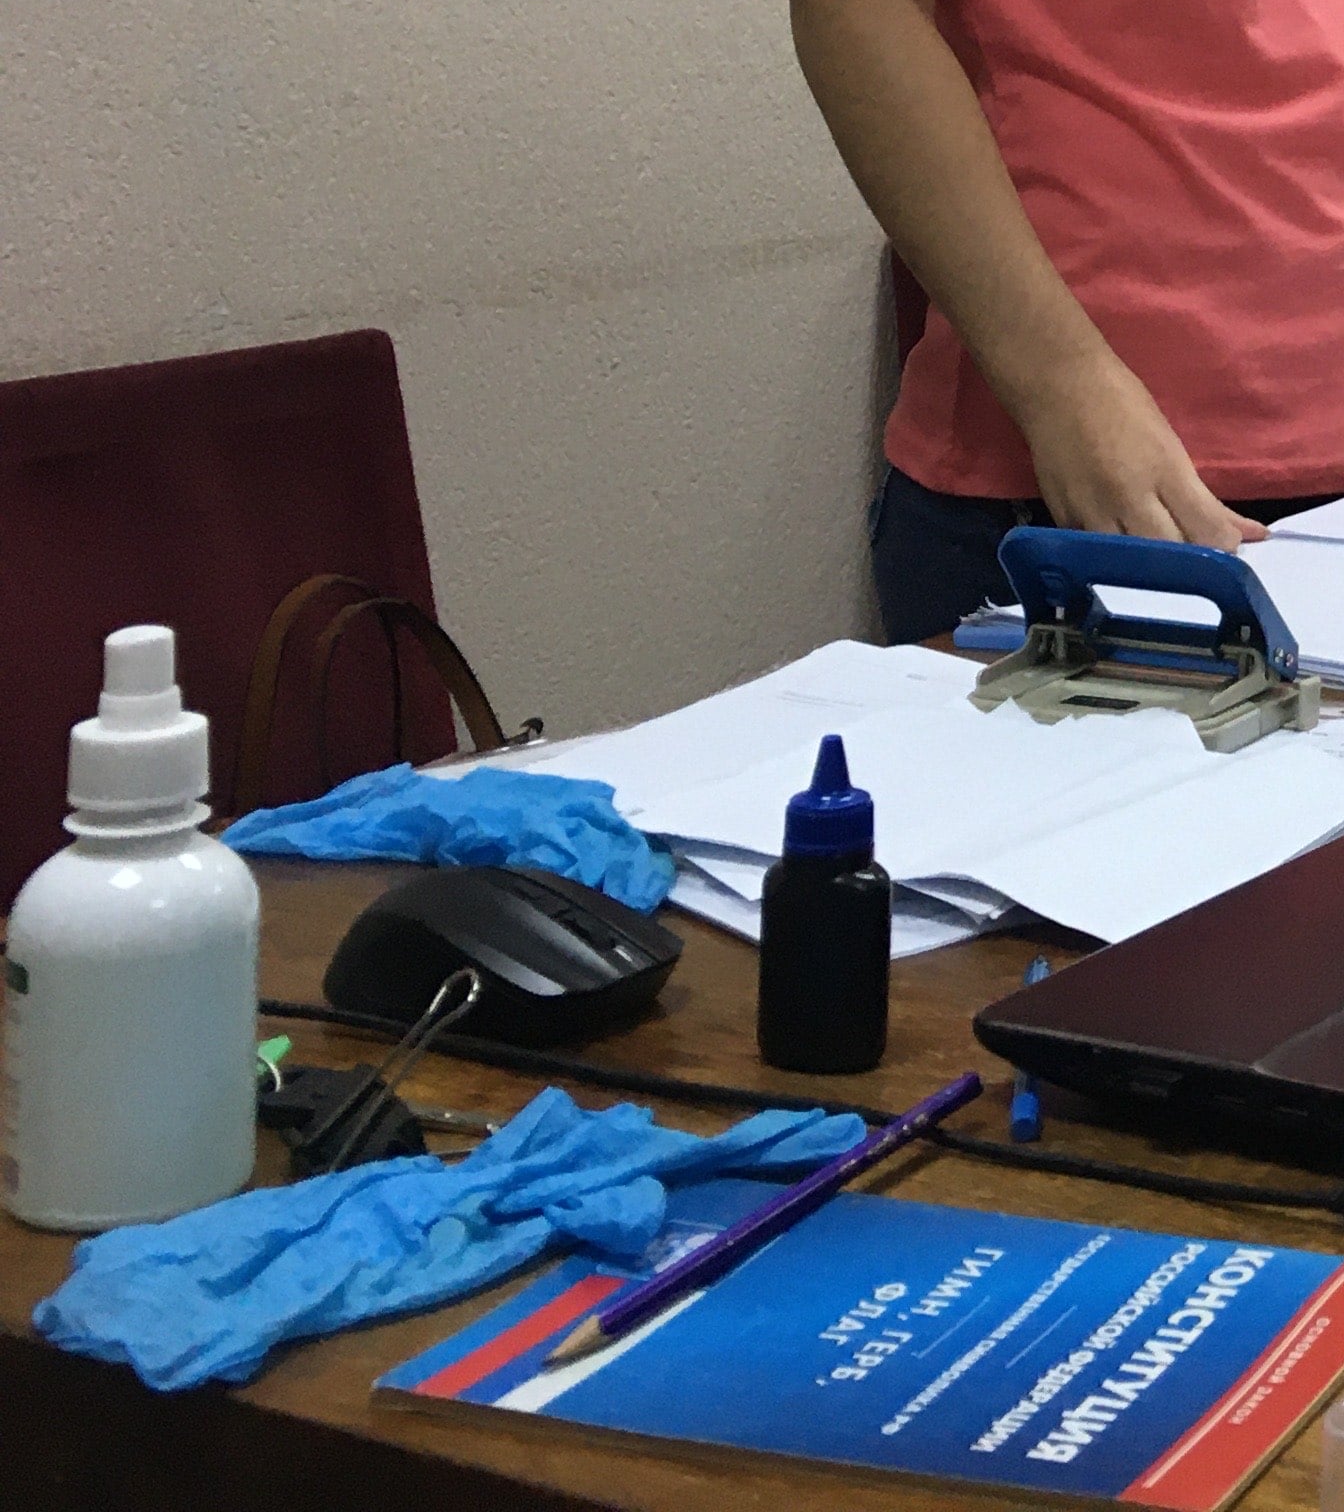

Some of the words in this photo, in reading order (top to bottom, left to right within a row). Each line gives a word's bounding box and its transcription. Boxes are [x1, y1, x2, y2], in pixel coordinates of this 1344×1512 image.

[818, 1282, 908, 1346] ФЛАГ
[897, 1246, 1006, 1321] ГИМН,
[1084, 1243, 1208, 1350] РОССИЙСКОЙ
[815, 1327, 914, 1387] ГЕРБ,
[1026, 1247, 1277, 1464] КОНСТИТУЦИЯ
[970, 1349, 1097, 1453] ФЕДЕРАЦИИ
